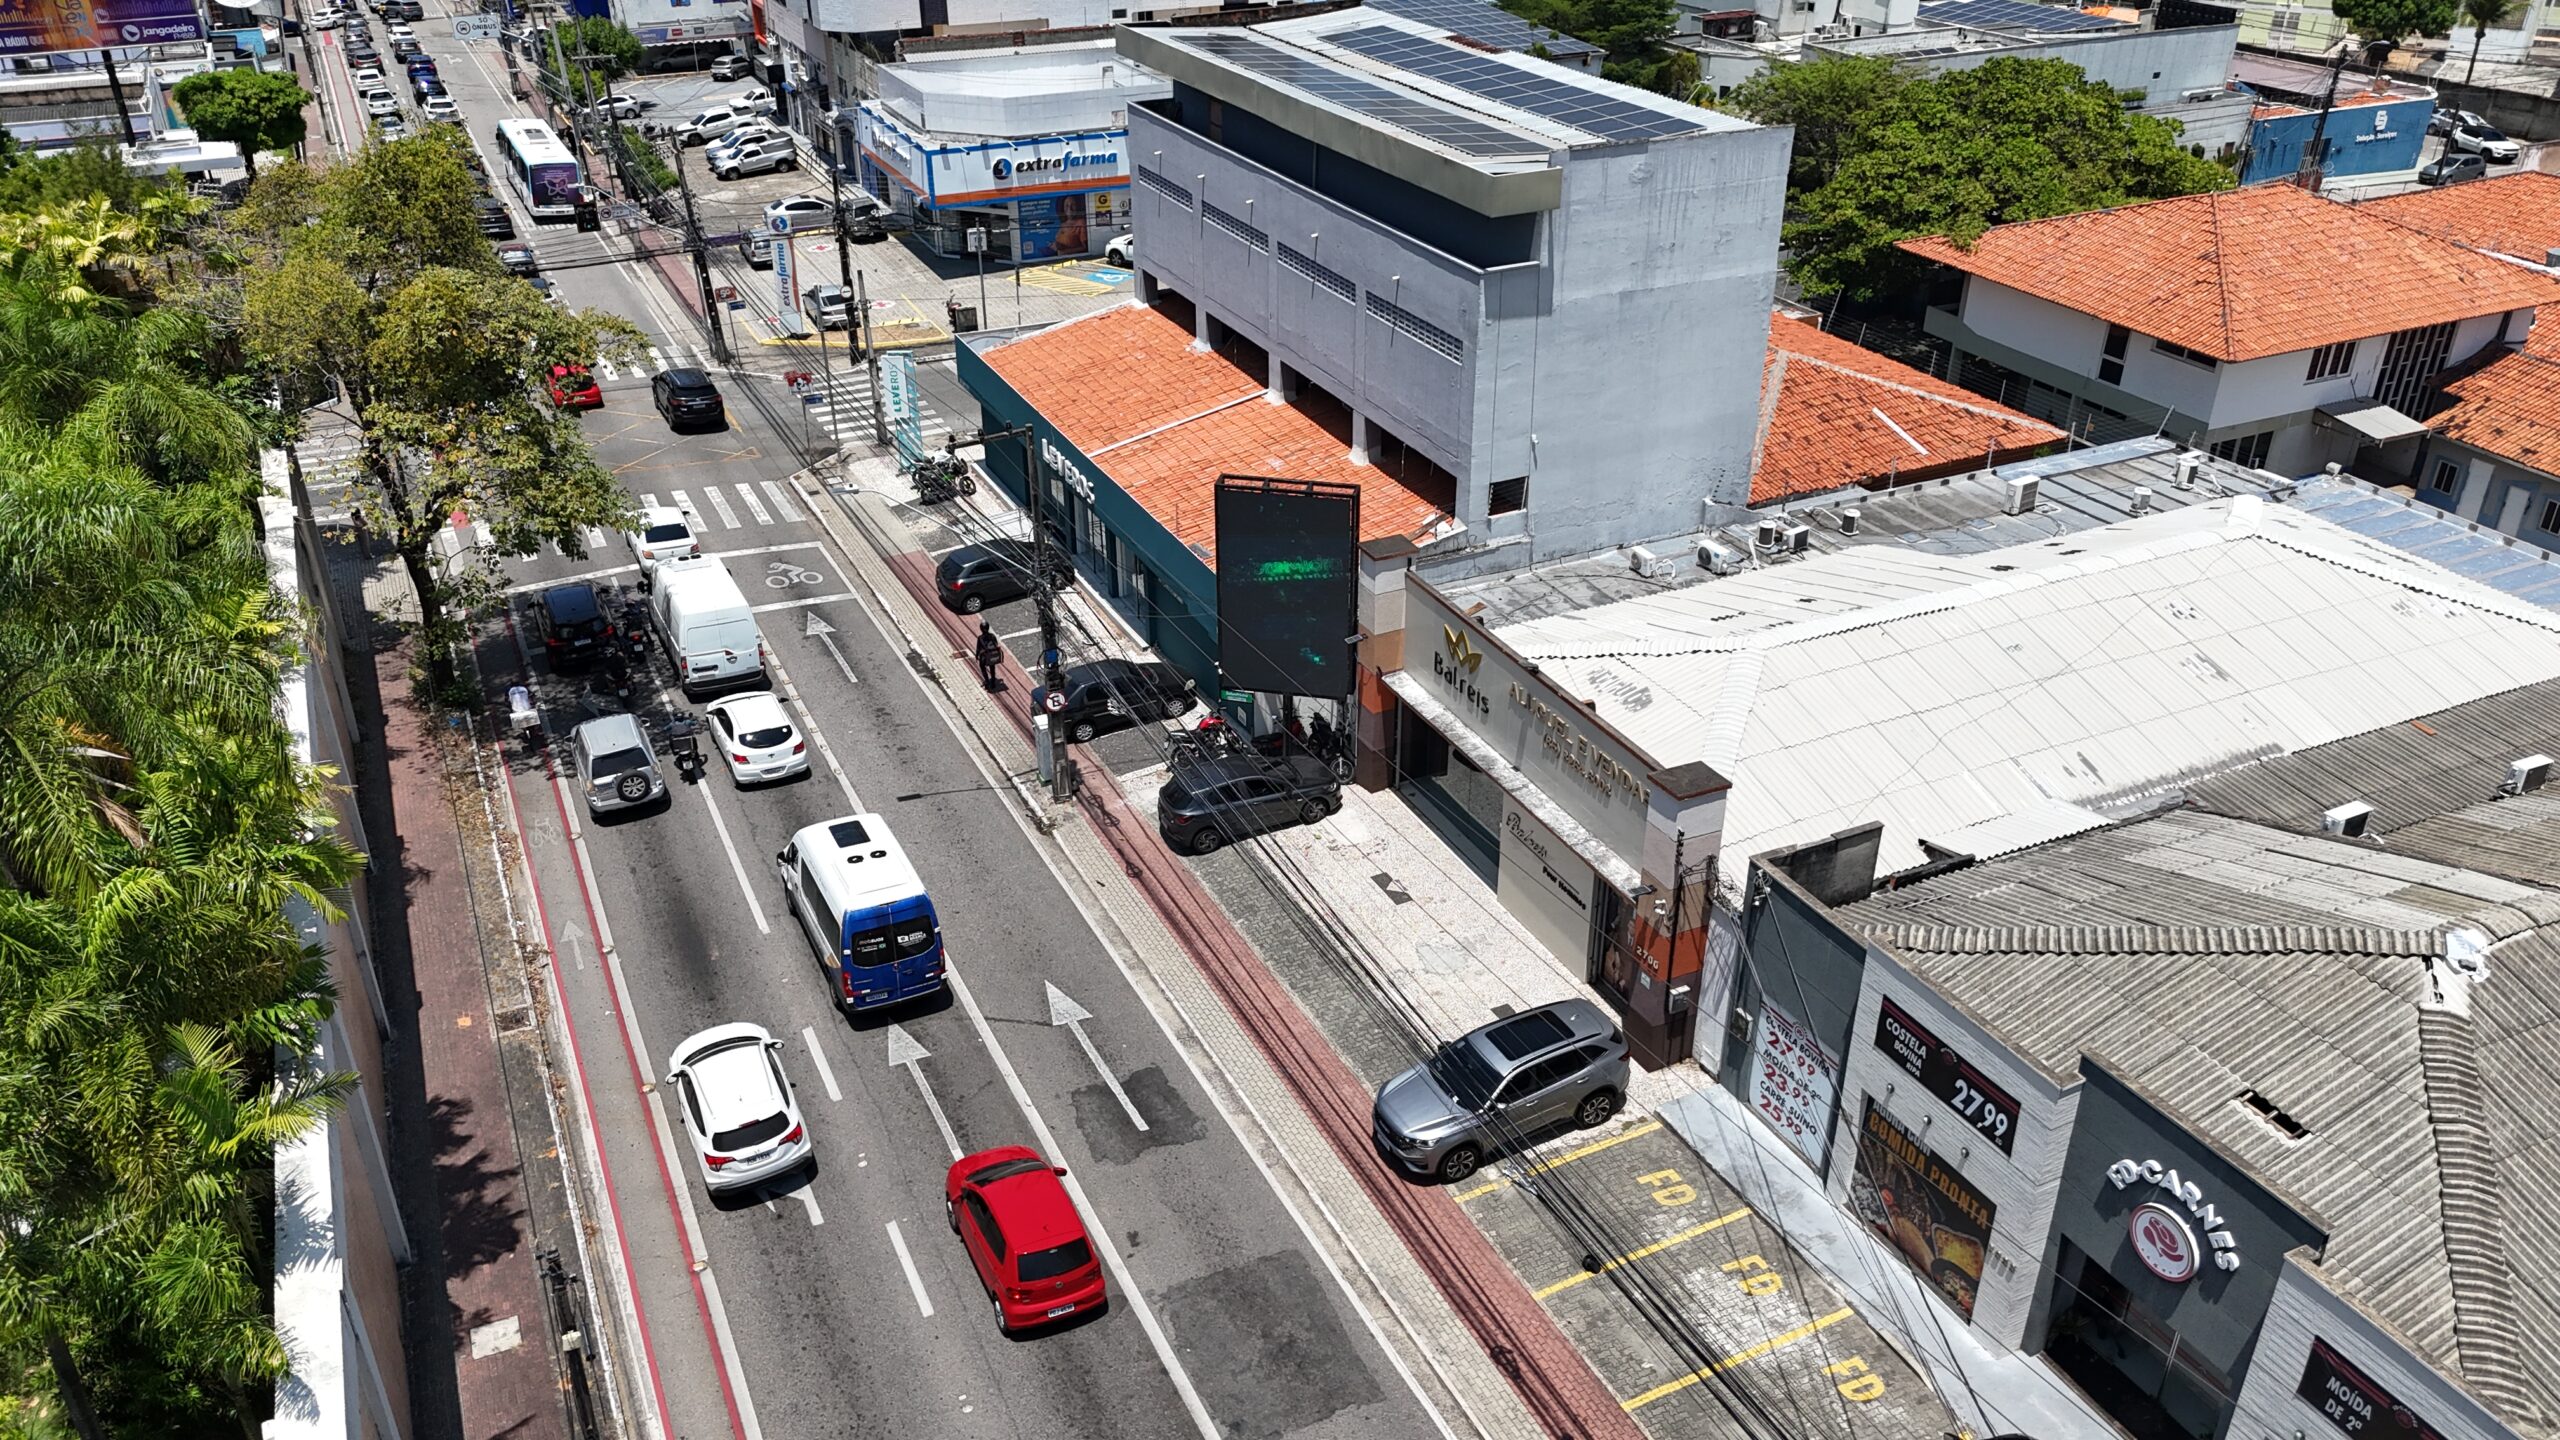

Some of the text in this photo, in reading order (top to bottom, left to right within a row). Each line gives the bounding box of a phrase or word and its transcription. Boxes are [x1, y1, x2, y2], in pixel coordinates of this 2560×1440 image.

[4, 36, 29, 47] RÁDIO
[142, 24, 195, 37] jangadeiro
[1015, 151, 1118, 173] extrafarma
[776, 243, 791, 307] extrafarma
[889, 364, 903, 413] LEVEROS
[1041, 438, 1096, 504] LEVEROS
[1434, 650, 1490, 714] Balreis
[1509, 681, 1574, 745] ALUGUEL
[1578, 734, 1588, 756] E
[1885, 1017, 1927, 1060] COSTELA
[1893, 1039, 1922, 1069] BOVINA
[1763, 1048, 1798, 1082] MOÍDA
[1796, 1078, 1810, 1092] DE
[1764, 1063, 1810, 1107] 23,99
[1905, 1062, 1921, 1078] RIPA
[1759, 1094, 1803, 1136] 25,99
[1788, 1105, 1818, 1136] SUÍNO
[1951, 1078, 2008, 1137] 27,99
[1636, 1168, 1698, 1206] FD
[1870, 1110, 1990, 1230] COMIDA PRONTA
[1721, 1254, 1784, 1297] FD
[1821, 1355, 1886, 1402] FD
[2326, 1375, 2373, 1421] MOÍDA
[2324, 1397, 2345, 1421] DE
